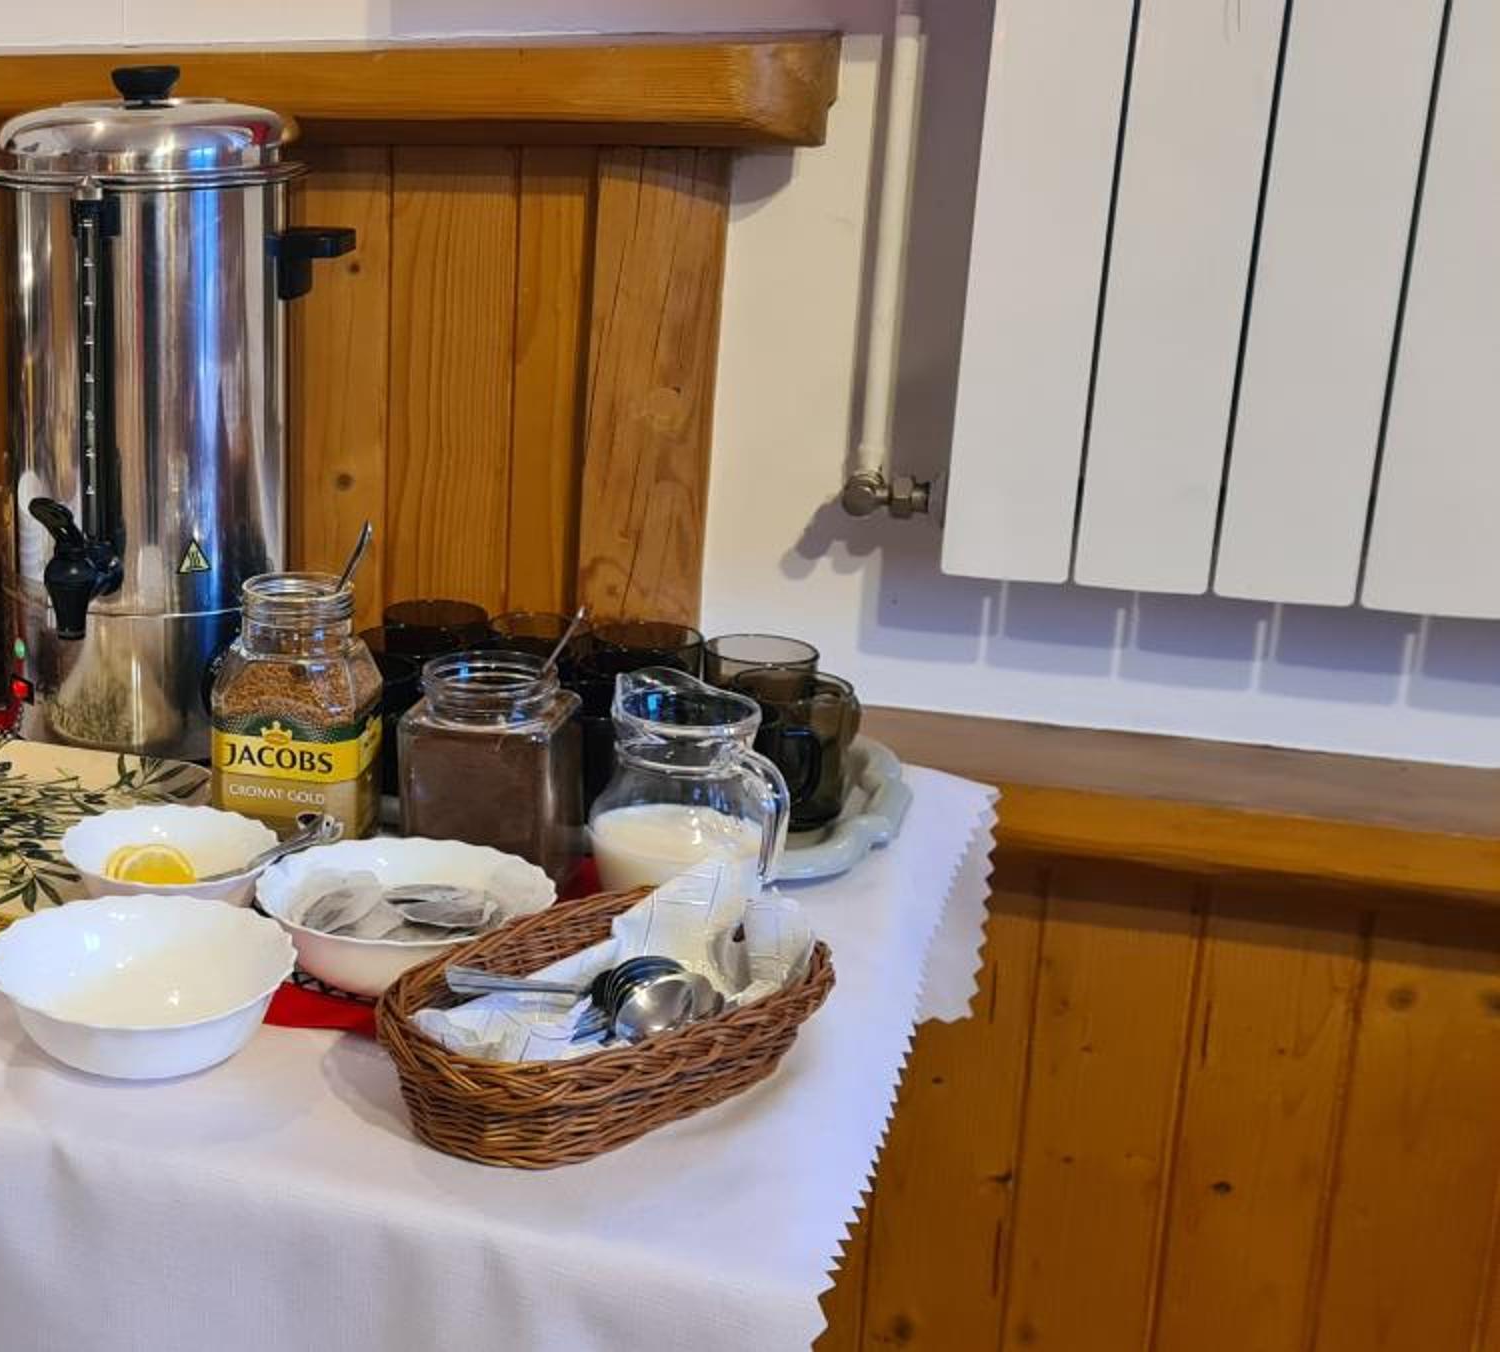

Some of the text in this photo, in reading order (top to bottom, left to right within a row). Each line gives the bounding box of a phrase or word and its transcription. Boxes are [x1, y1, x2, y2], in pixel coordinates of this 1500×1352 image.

[223, 743, 333, 774] JACOBS
[228, 783, 325, 806] CRONAT GOLD
